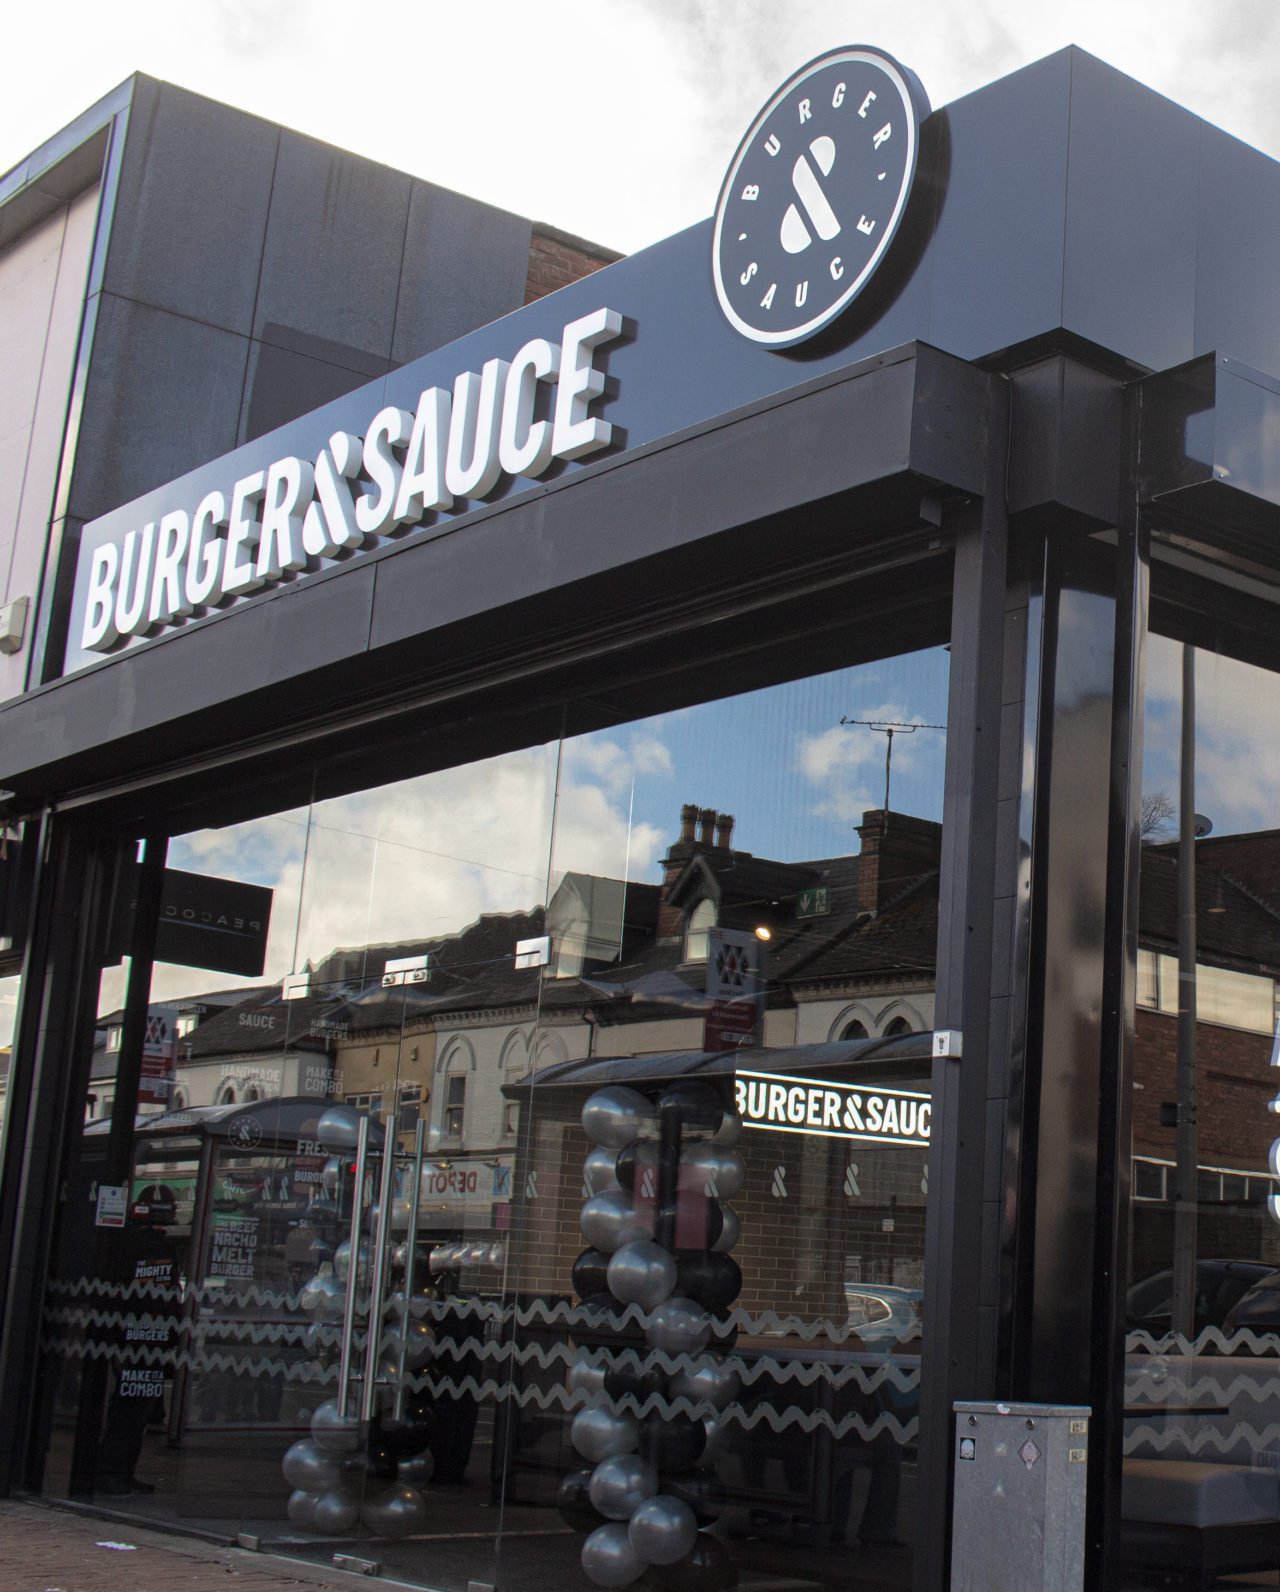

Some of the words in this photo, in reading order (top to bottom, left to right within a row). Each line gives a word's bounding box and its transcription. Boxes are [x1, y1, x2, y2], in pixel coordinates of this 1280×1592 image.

[741, 82, 892, 201] BURGER
[739, 214, 877, 310] SAUCE
[238, 1013, 277, 1029] SAUCE
[310, 1017, 349, 1031] HANDMADE
[309, 1027, 348, 1041] BURGERS
[220, 1064, 281, 1082] HANDMADE
[306, 1066, 333, 1079] MAKE
[304, 1078, 344, 1095] COMBO
[295, 1138, 333, 1158] FRES
[294, 1170, 321, 1183] BURG
[213, 1231, 258, 1248] NACHO
[211, 1246, 257, 1264] MELT
[135, 1264, 173, 1278] MIGHTY
[210, 1262, 255, 1277] BURGER
[121, 1369, 152, 1382] MAKE
[120, 1382, 163, 1397] COMBO
